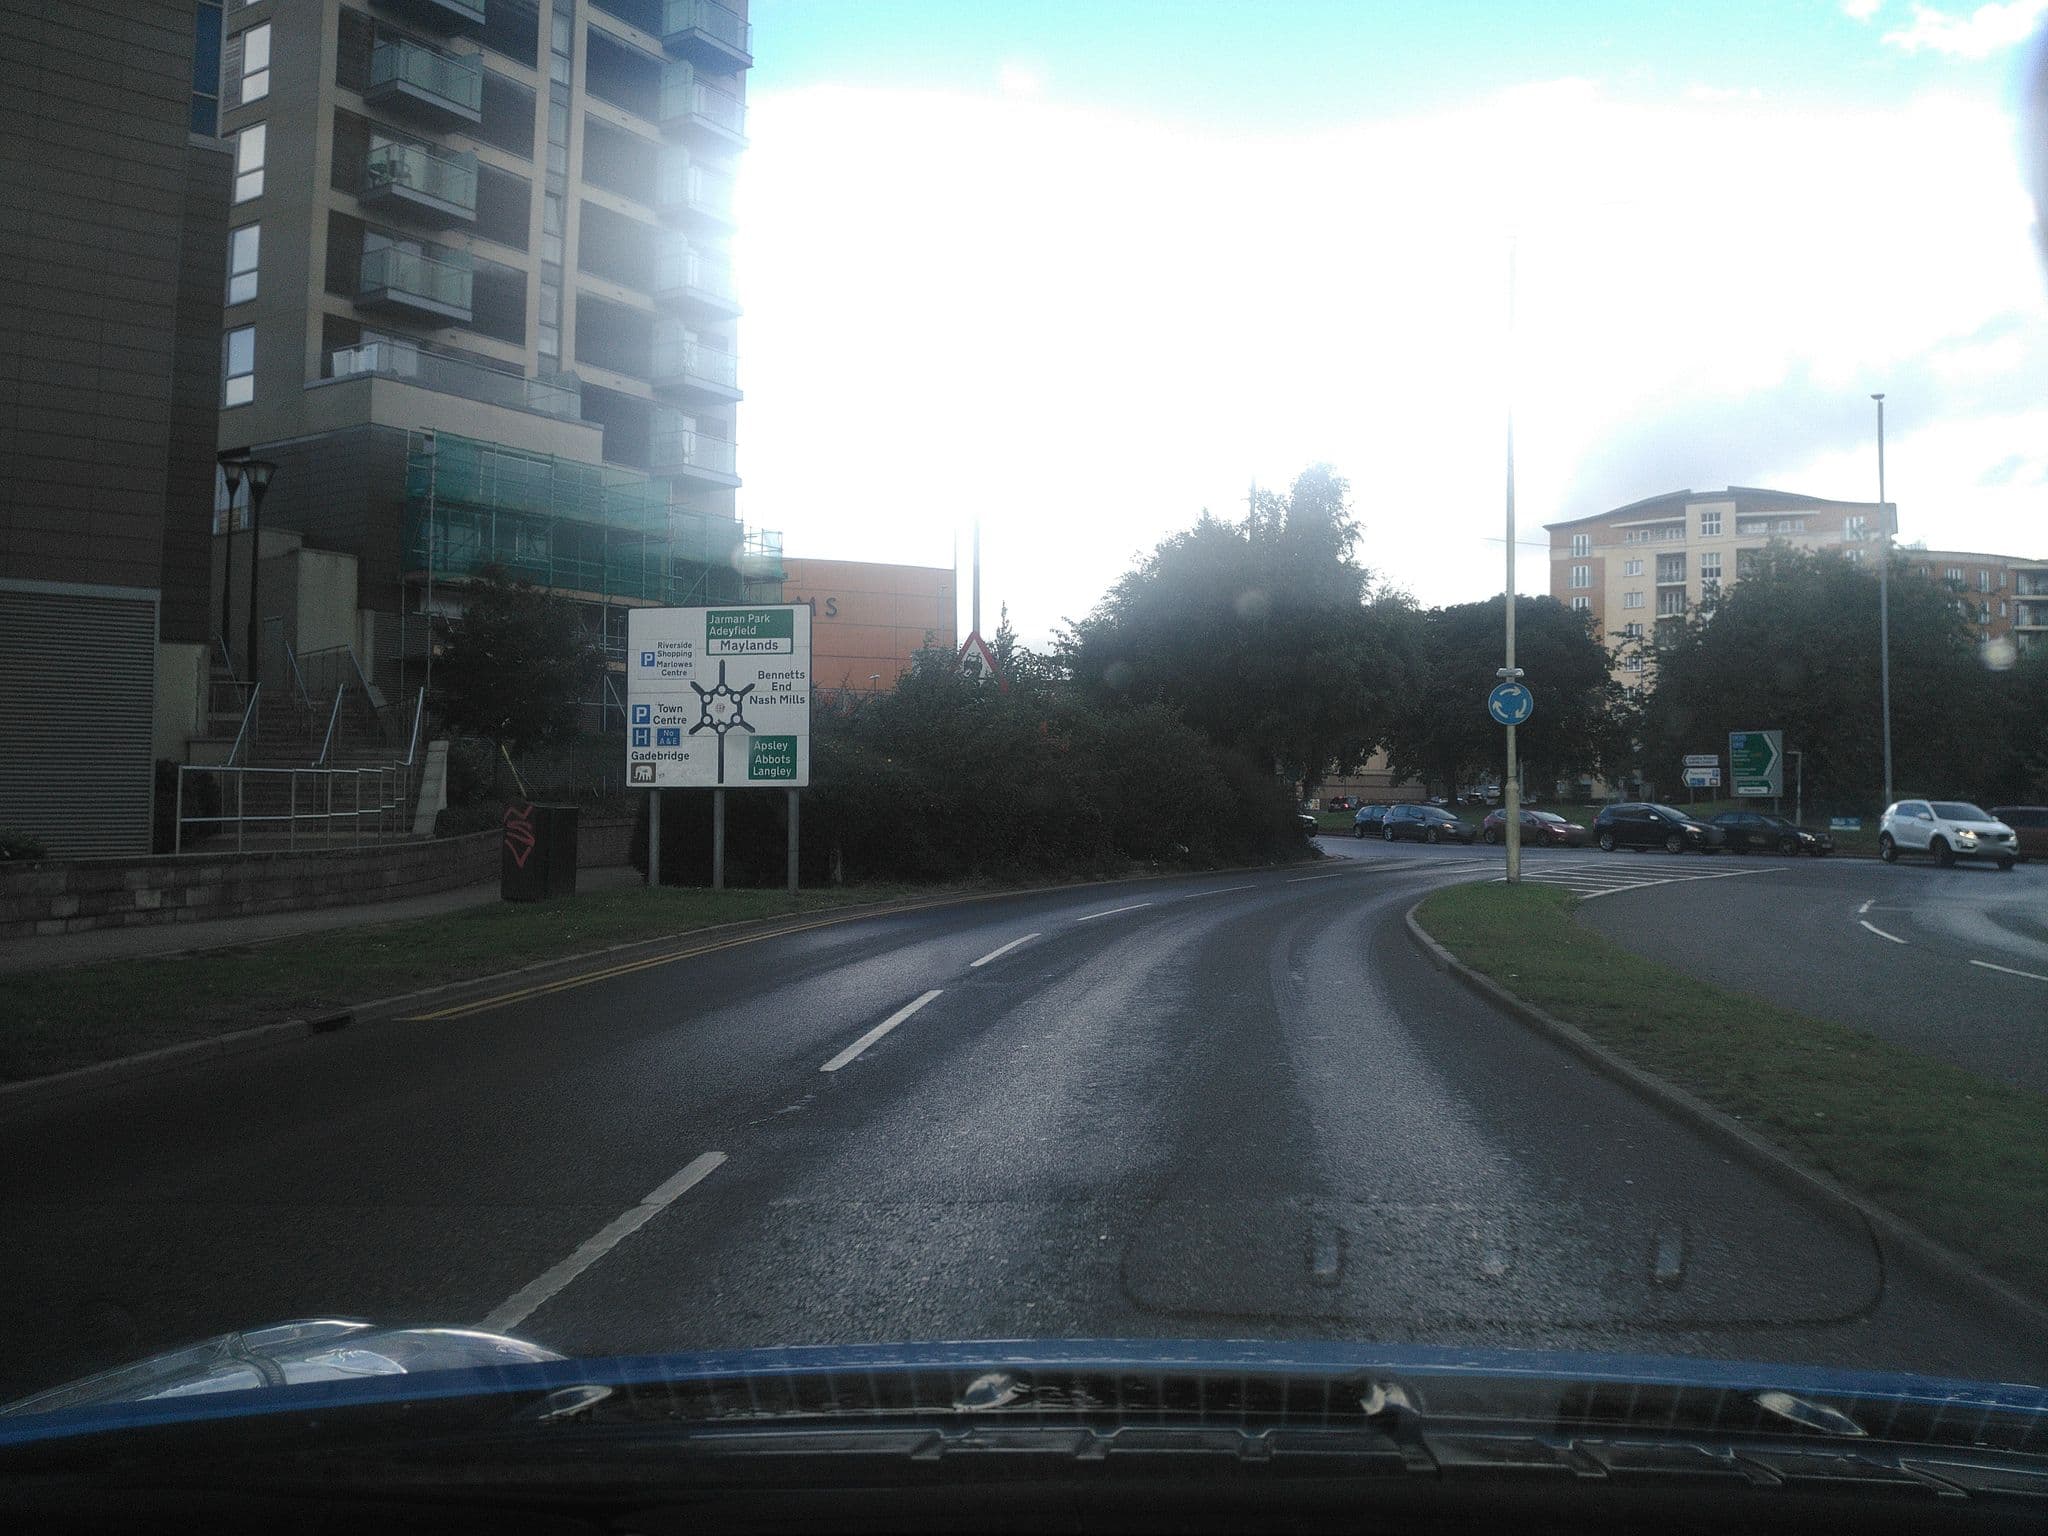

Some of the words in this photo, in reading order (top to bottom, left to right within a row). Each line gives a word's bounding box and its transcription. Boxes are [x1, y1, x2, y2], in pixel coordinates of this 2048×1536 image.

[709, 615, 745, 624] Jarman
[748, 614, 770, 623] Park
[709, 626, 756, 636] Adeyfield
[720, 640, 778, 652] Maylands
[658, 650, 692, 658] Shopping
[758, 670, 805, 680] Bennetts
[772, 682, 792, 691] End
[750, 696, 776, 705] Nash
[779, 695, 805, 704] Mills
[658, 704, 683, 713] Town
[653, 716, 687, 725] Centre
[636, 732, 647, 744] H
[754, 741, 788, 751] Apsley
[631, 751, 689, 761] Gadebridge
[755, 755, 791, 764] Abbots
[753, 767, 791, 777] Langley
